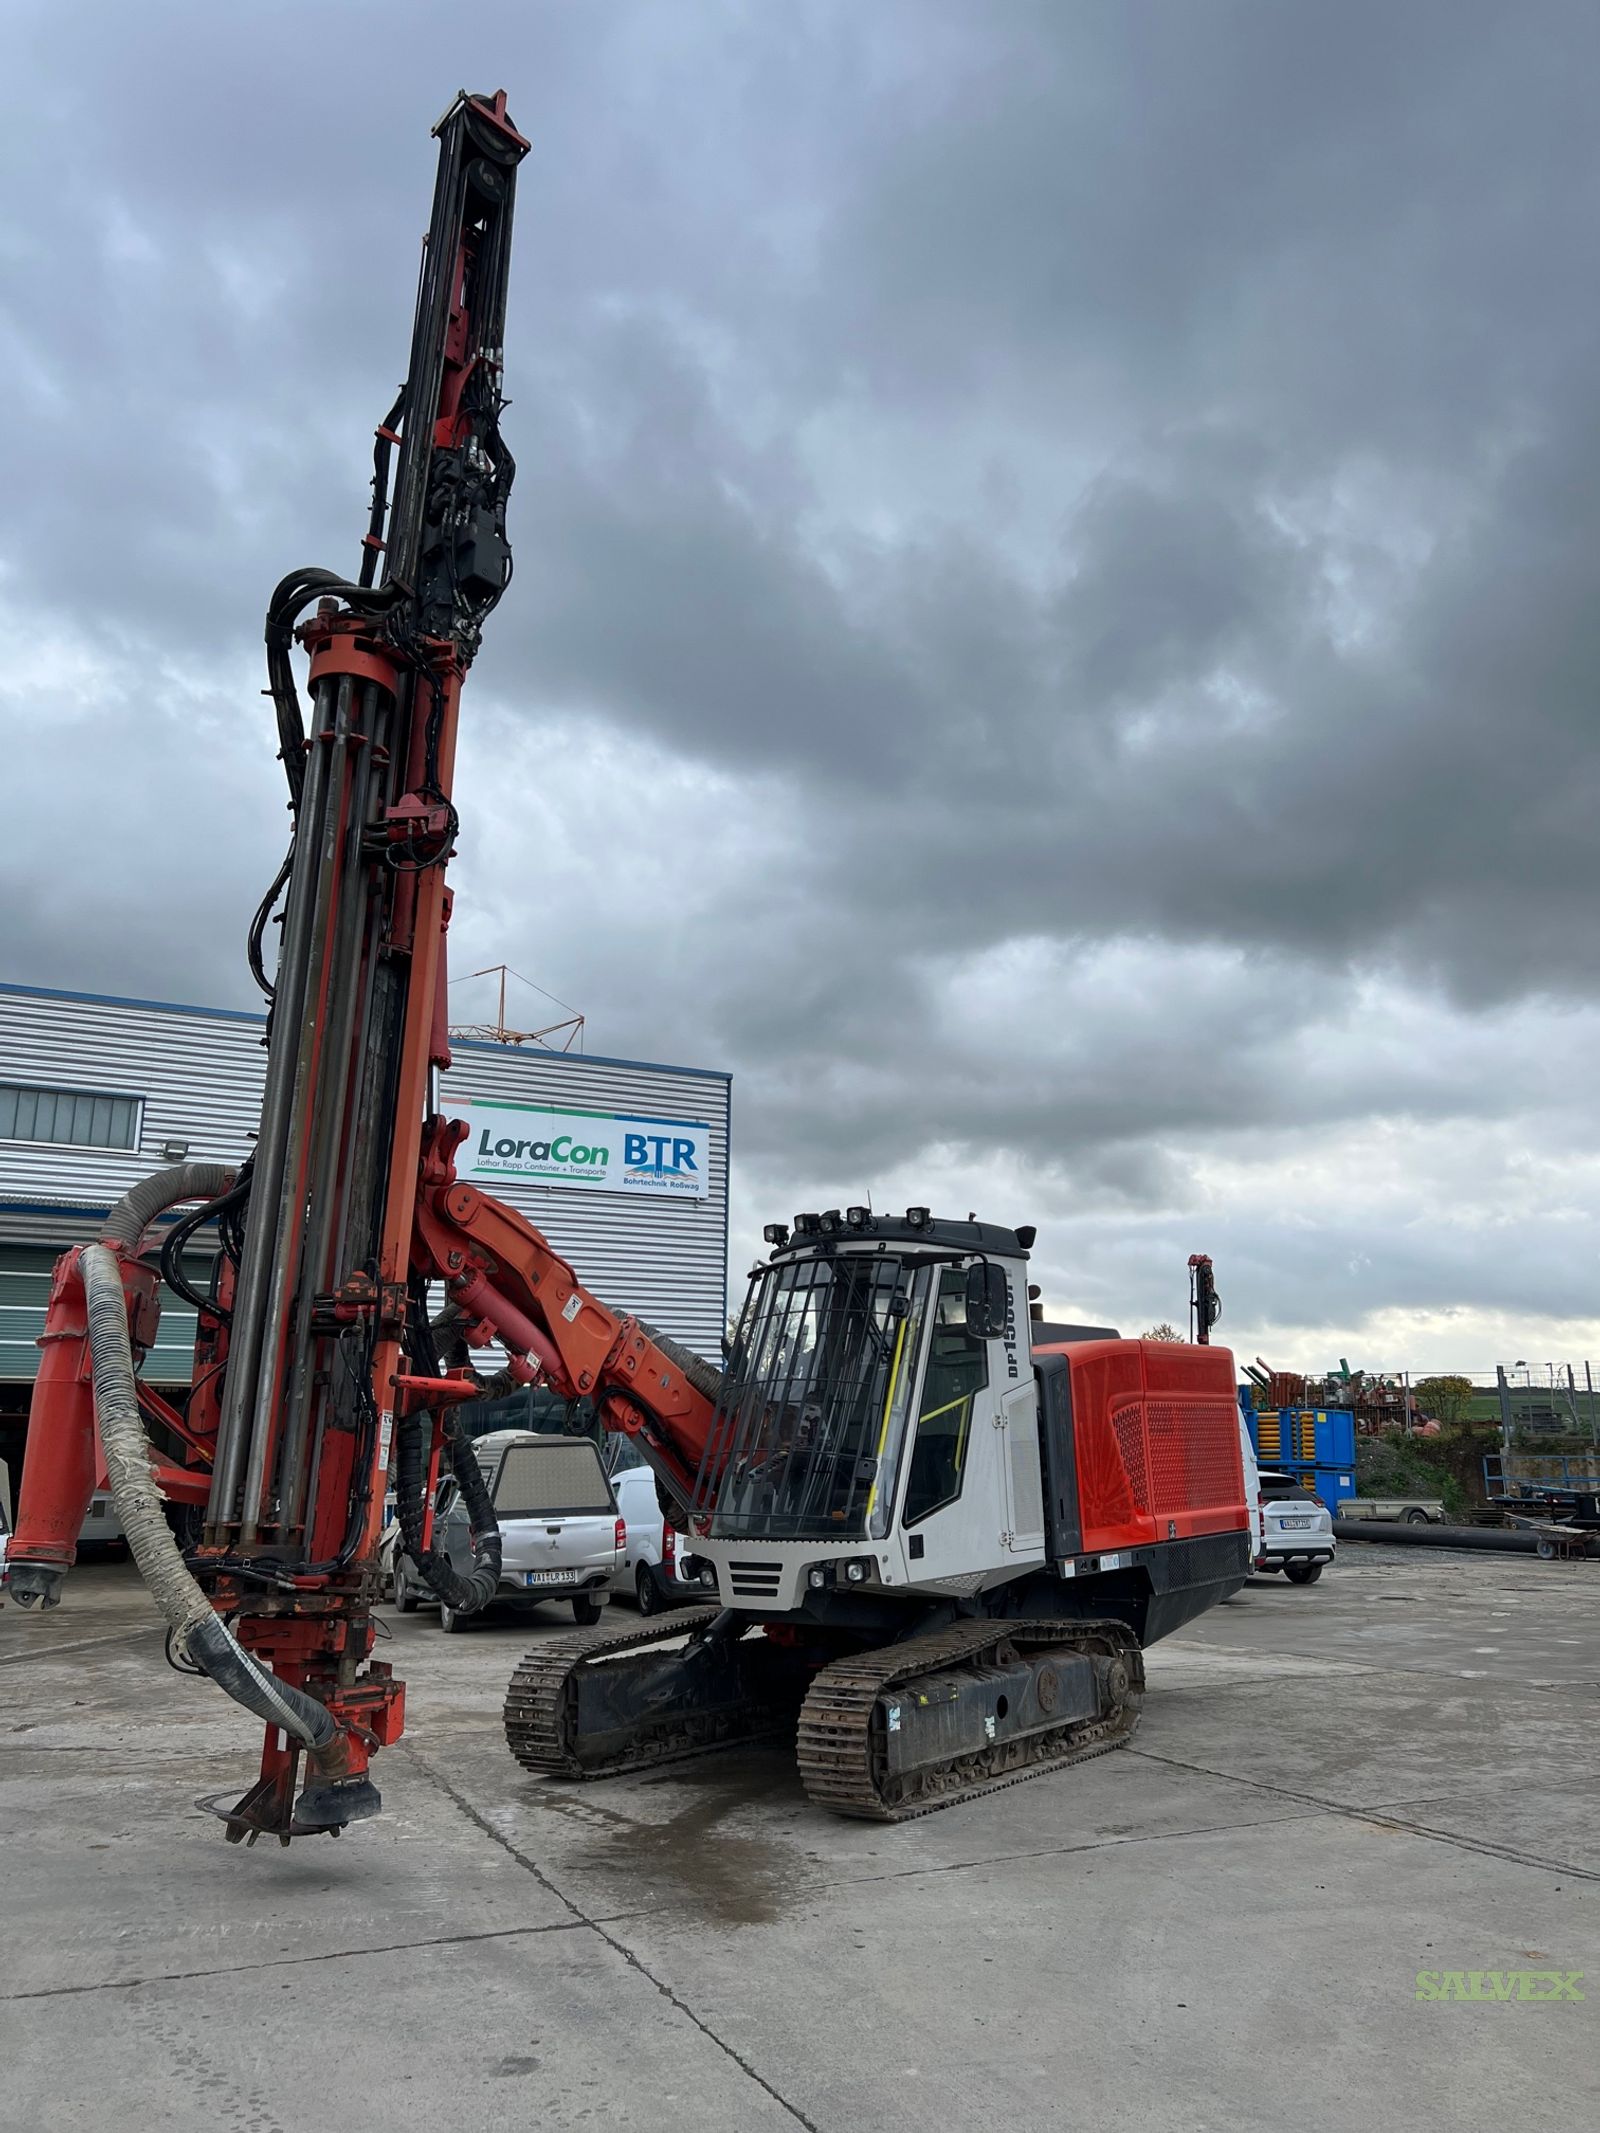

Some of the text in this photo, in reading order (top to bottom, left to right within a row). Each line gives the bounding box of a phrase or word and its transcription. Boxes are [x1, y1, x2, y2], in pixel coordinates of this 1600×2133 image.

[478, 1129, 610, 1166] LoraCon
[624, 1133, 699, 1171] BTR
[477, 1158, 501, 1167] Lothar
[502, 1160, 523, 1171] Rapp
[524, 1162, 560, 1172] Container
[569, 1165, 607, 1176] Transporte
[623, 1178, 700, 1191] Bohrtechnik Roßwag
